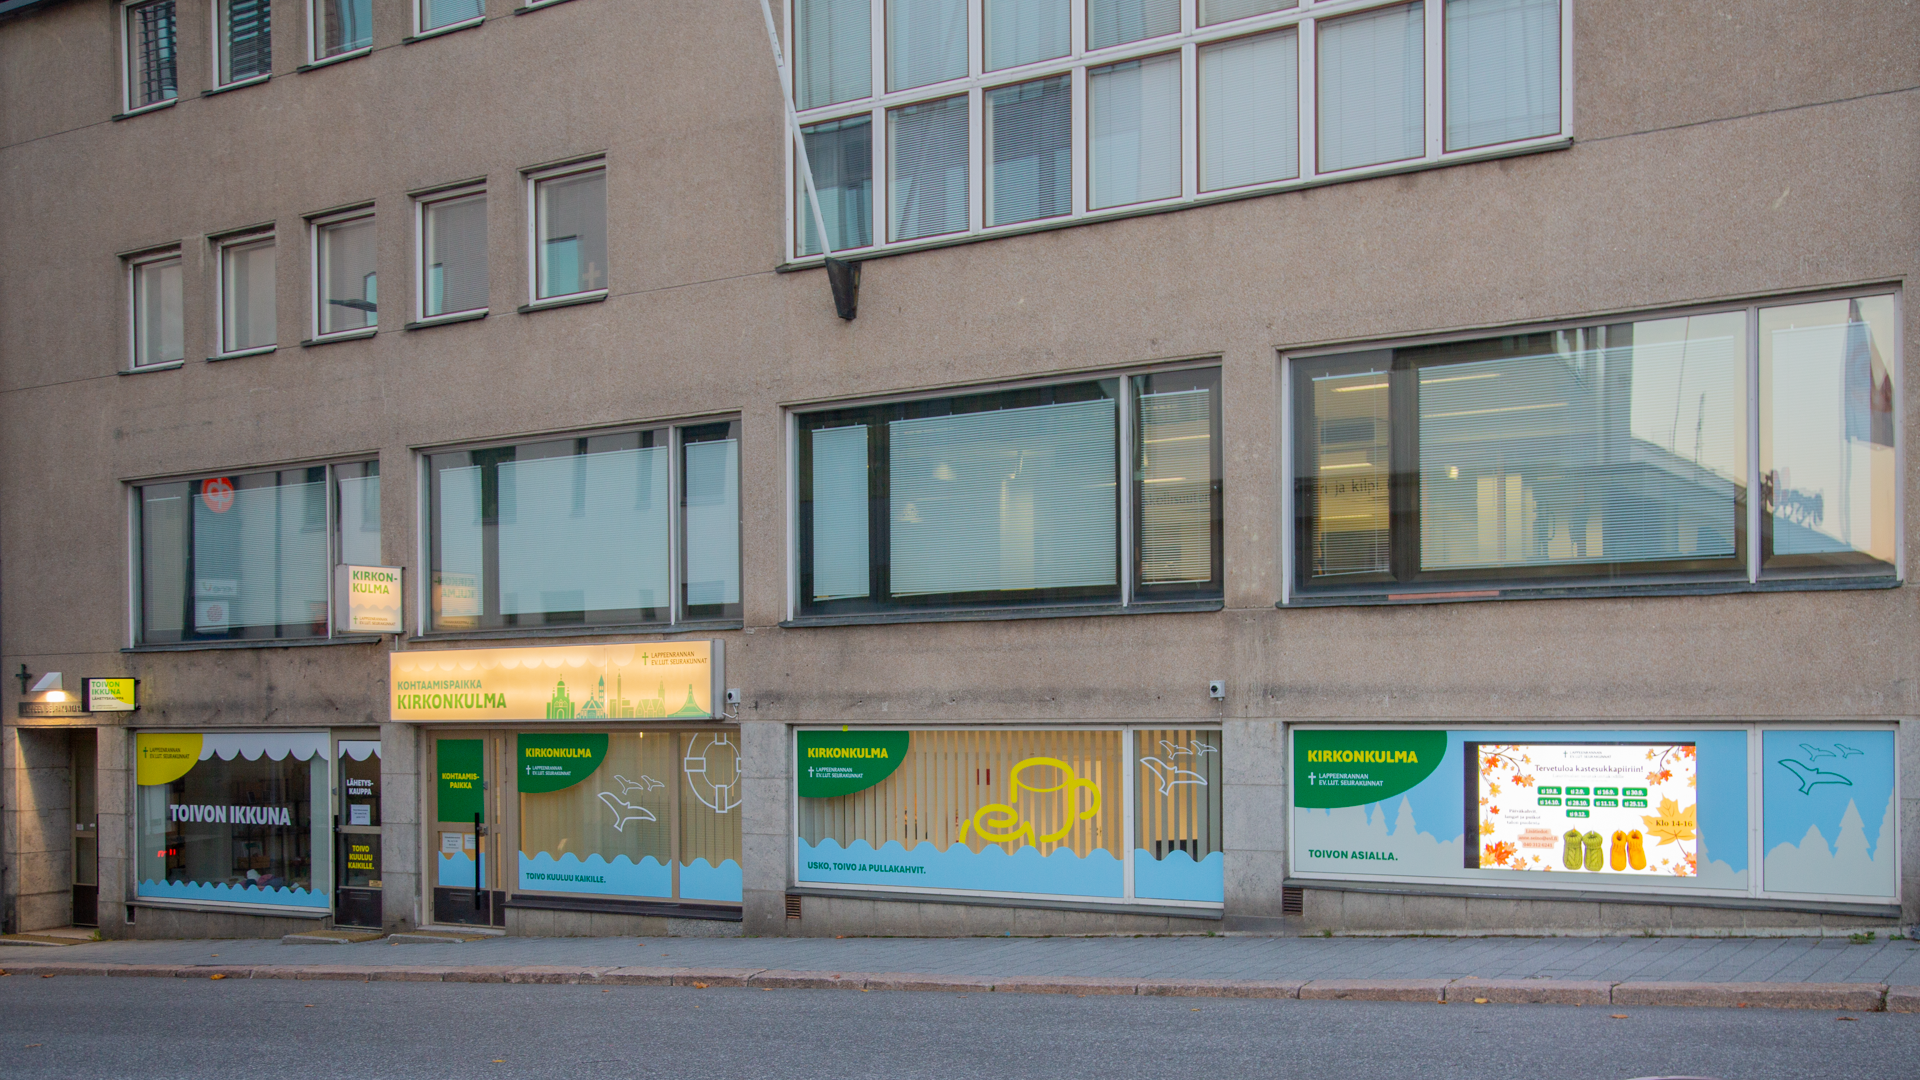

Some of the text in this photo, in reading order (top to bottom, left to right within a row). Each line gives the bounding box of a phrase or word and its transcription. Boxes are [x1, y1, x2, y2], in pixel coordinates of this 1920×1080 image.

[352, 570, 398, 582] KIRKON-
[352, 582, 390, 594] KULMA
[397, 680, 482, 690] KOHTAAMISPAIKKA
[397, 693, 507, 710] KIRKONKULMA
[526, 748, 592, 758] KIRKONKULMA
[808, 747, 888, 758] KIRKONKULMA
[1308, 750, 1418, 763] KIRKONKULMA
[1575, 764, 1644, 774] kastesukkapiiriin!
[347, 778, 374, 786] LÄHETYS-
[170, 804, 291, 826] TOIVON IKKUNA
[1308, 849, 1398, 861] TOIVON ASIALLA.
[807, 862, 926, 874] USKO, TOIVO JA PULLAKAHVIT.
[546, 873, 574, 881] KUULUU
[575, 875, 606, 883] KAIKILLE.
